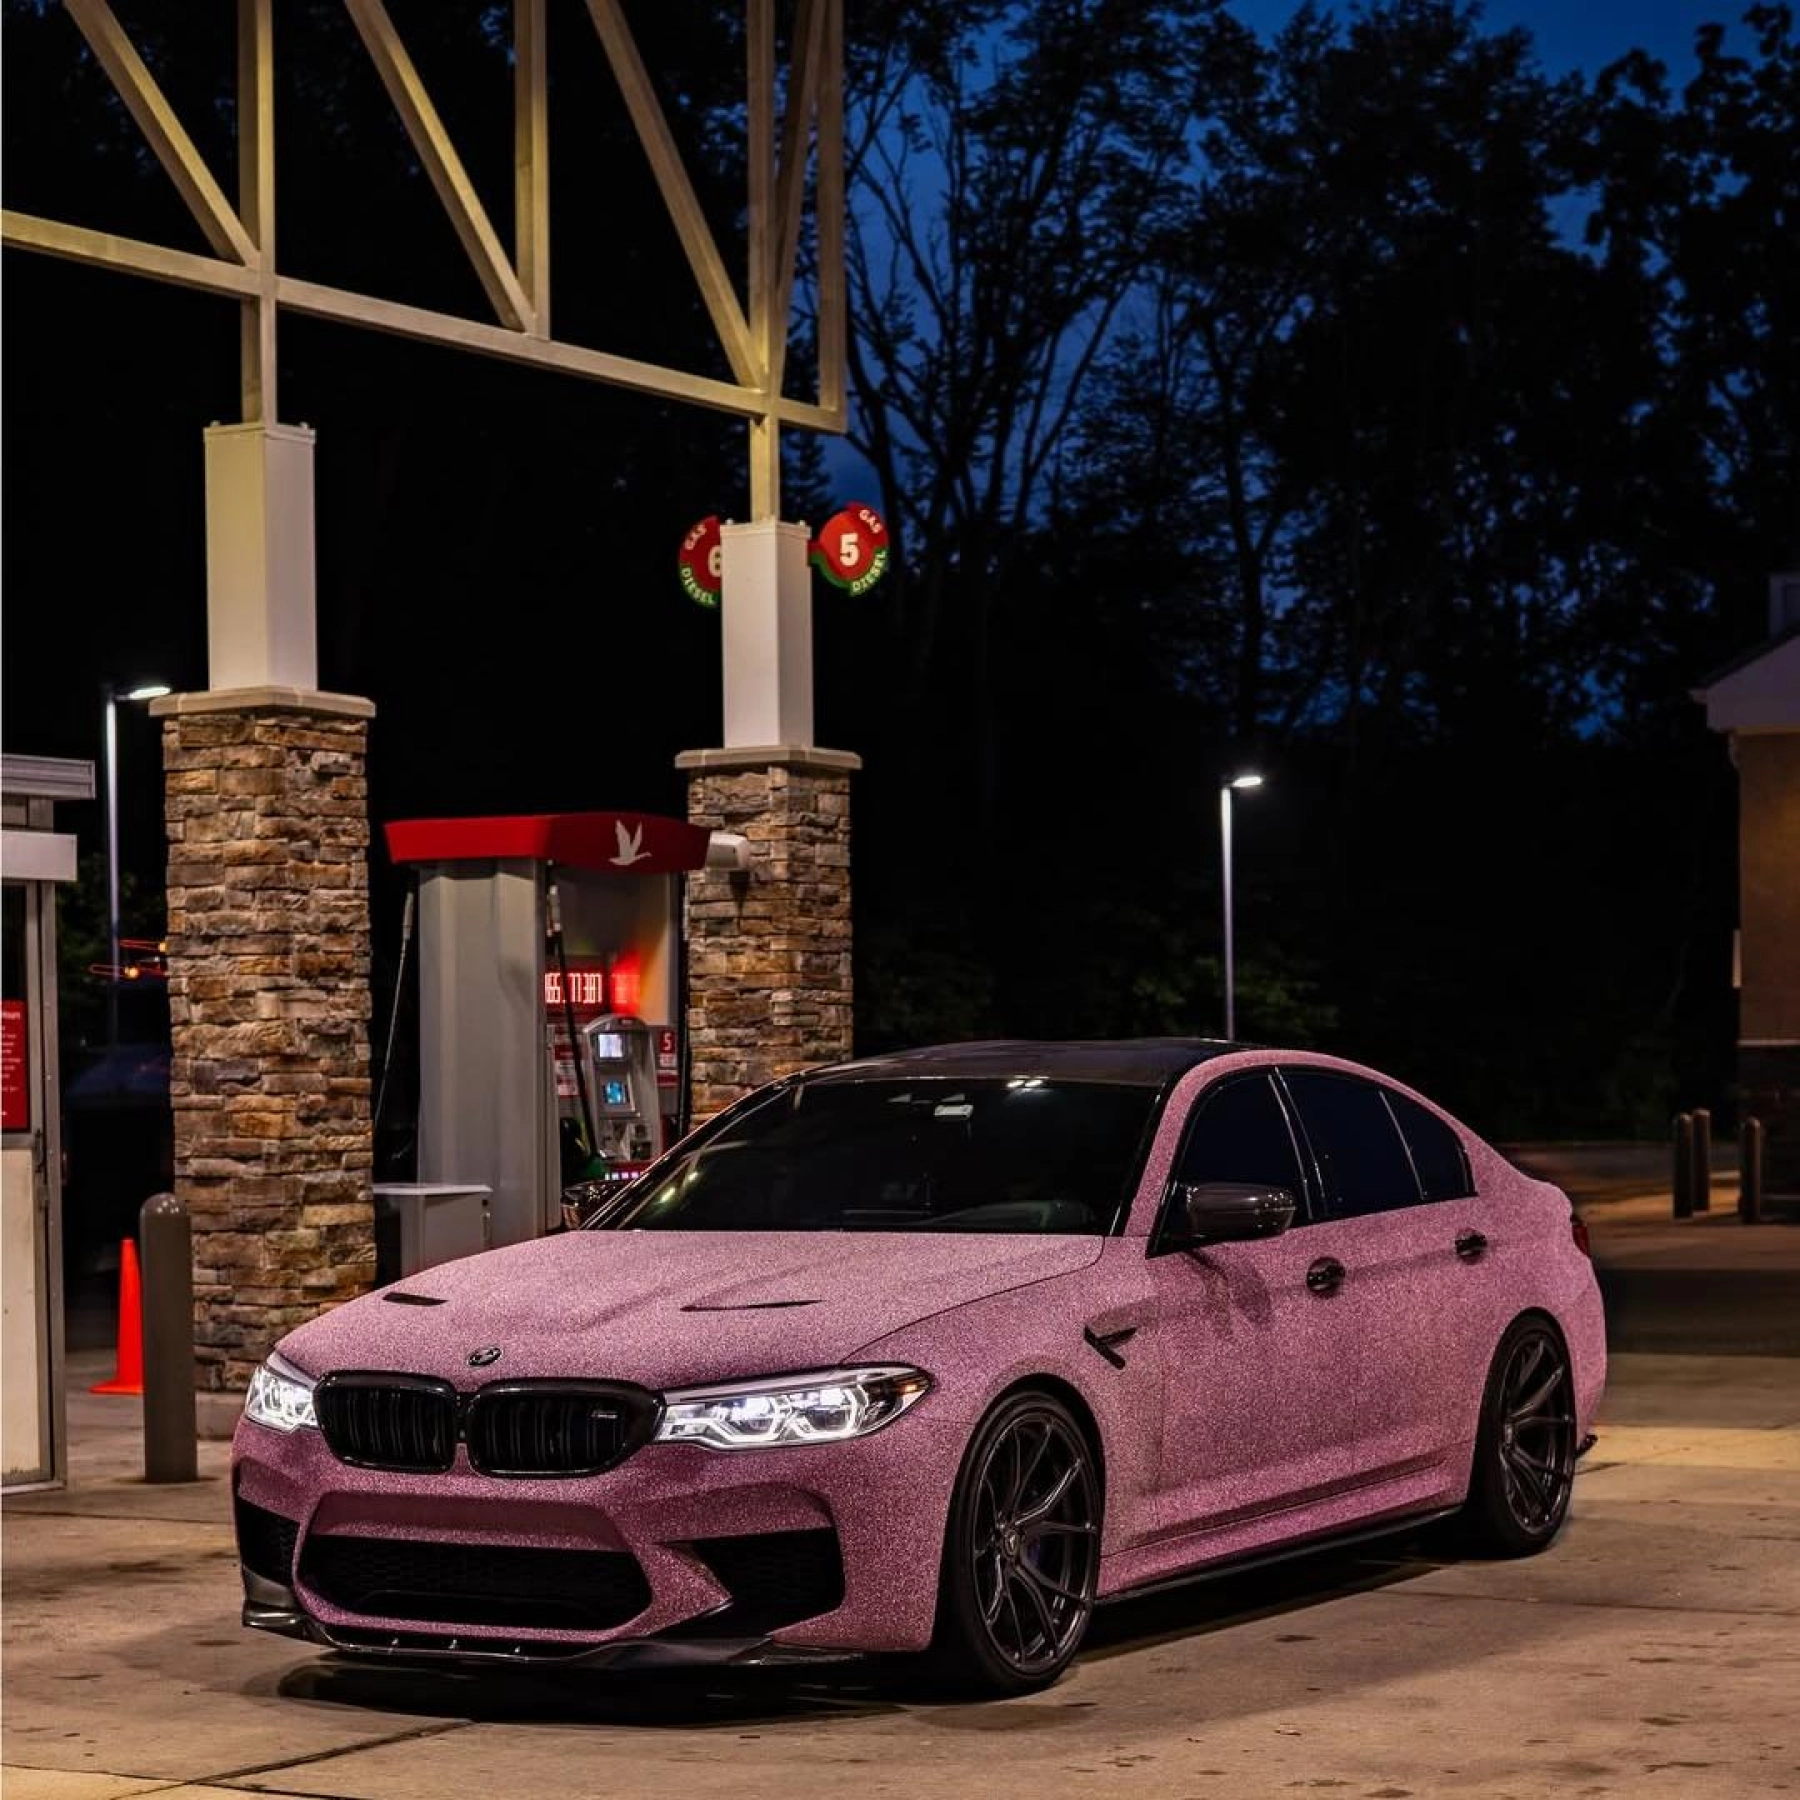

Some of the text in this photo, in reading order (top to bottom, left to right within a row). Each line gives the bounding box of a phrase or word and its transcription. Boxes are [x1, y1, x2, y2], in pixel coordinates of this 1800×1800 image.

[684, 521, 707, 550] GAS
[859, 509, 883, 534] GAS
[840, 533, 860, 567] 5
[681, 567, 716, 604] DIESEL
[852, 551, 887, 593] DIESEL
